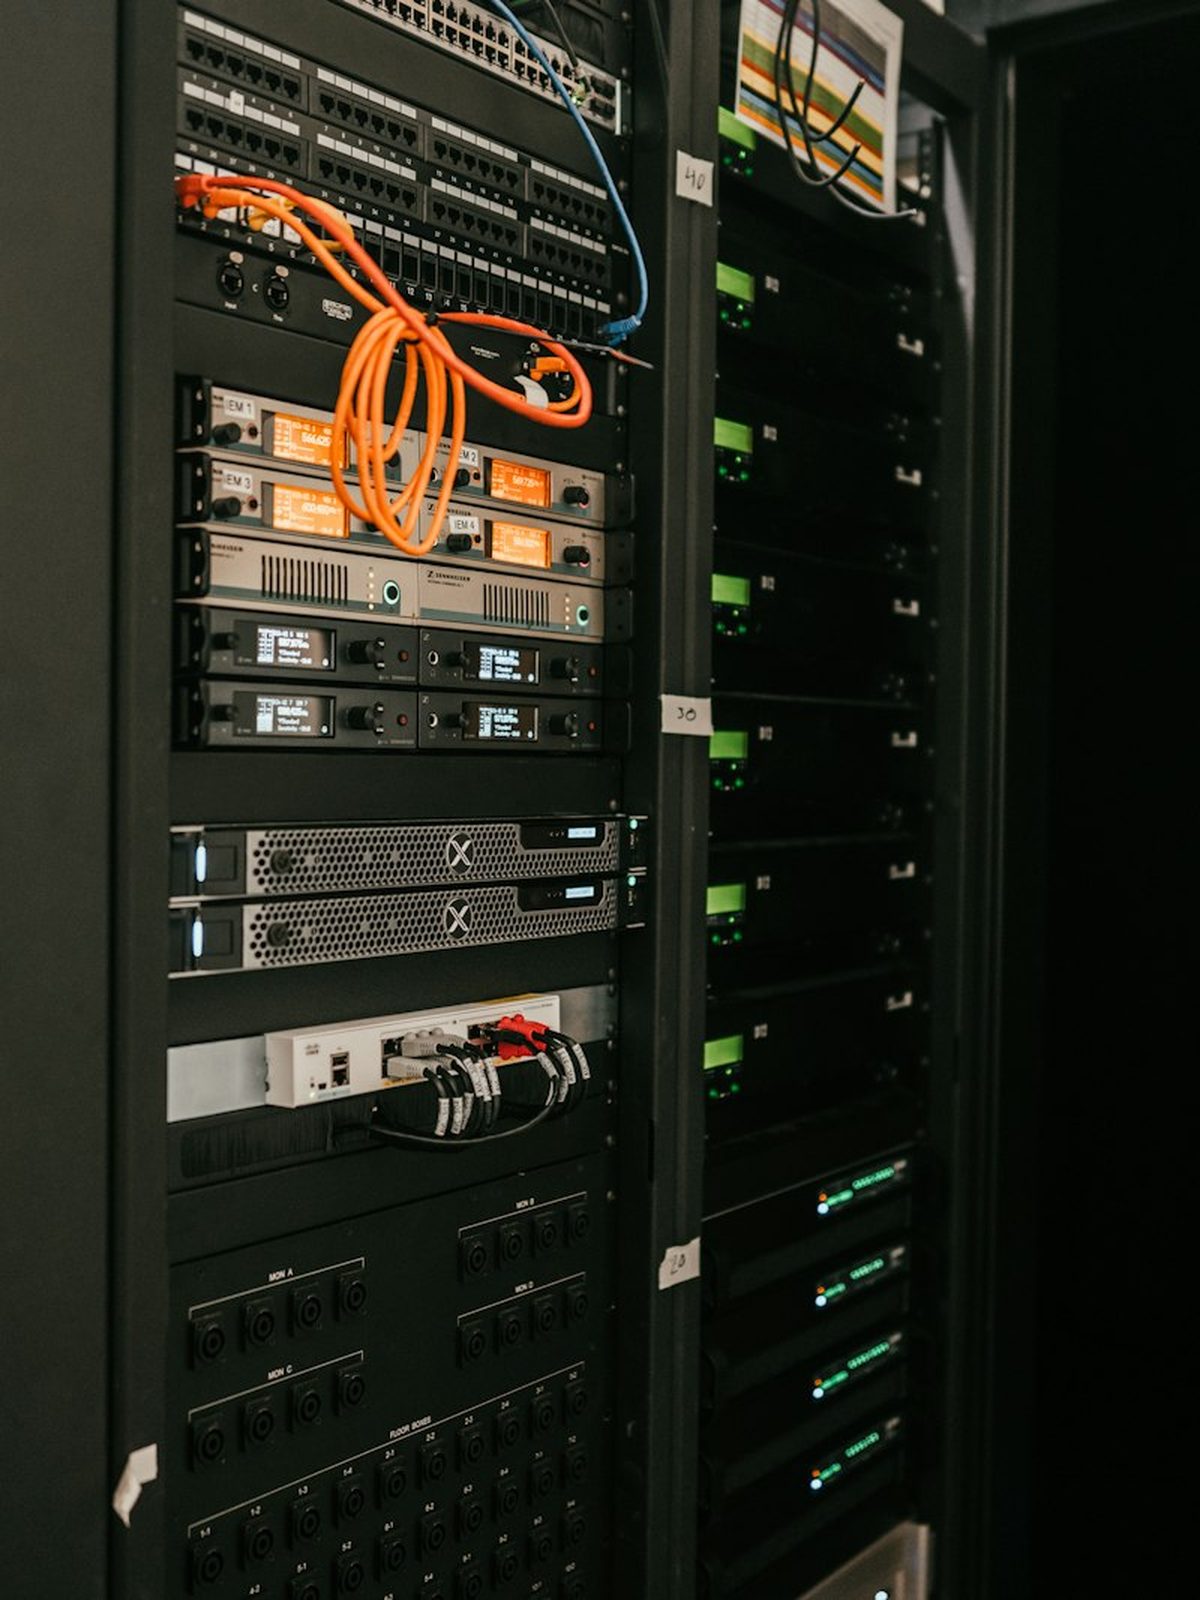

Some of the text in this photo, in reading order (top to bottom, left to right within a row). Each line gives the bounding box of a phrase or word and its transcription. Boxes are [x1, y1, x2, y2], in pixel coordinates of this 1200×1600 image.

[685, 166, 705, 190] 40
[200, 221, 208, 231] 2
[224, 228, 231, 238] 3
[311, 256, 317, 265] 7
[252, 283, 259, 293] C
[471, 451, 477, 462] 2
[244, 477, 250, 489] 3
[454, 519, 468, 530] IEM
[677, 707, 697, 722] 30
[268, 1267, 294, 1282] MON A
[267, 1364, 293, 1380] MON C
